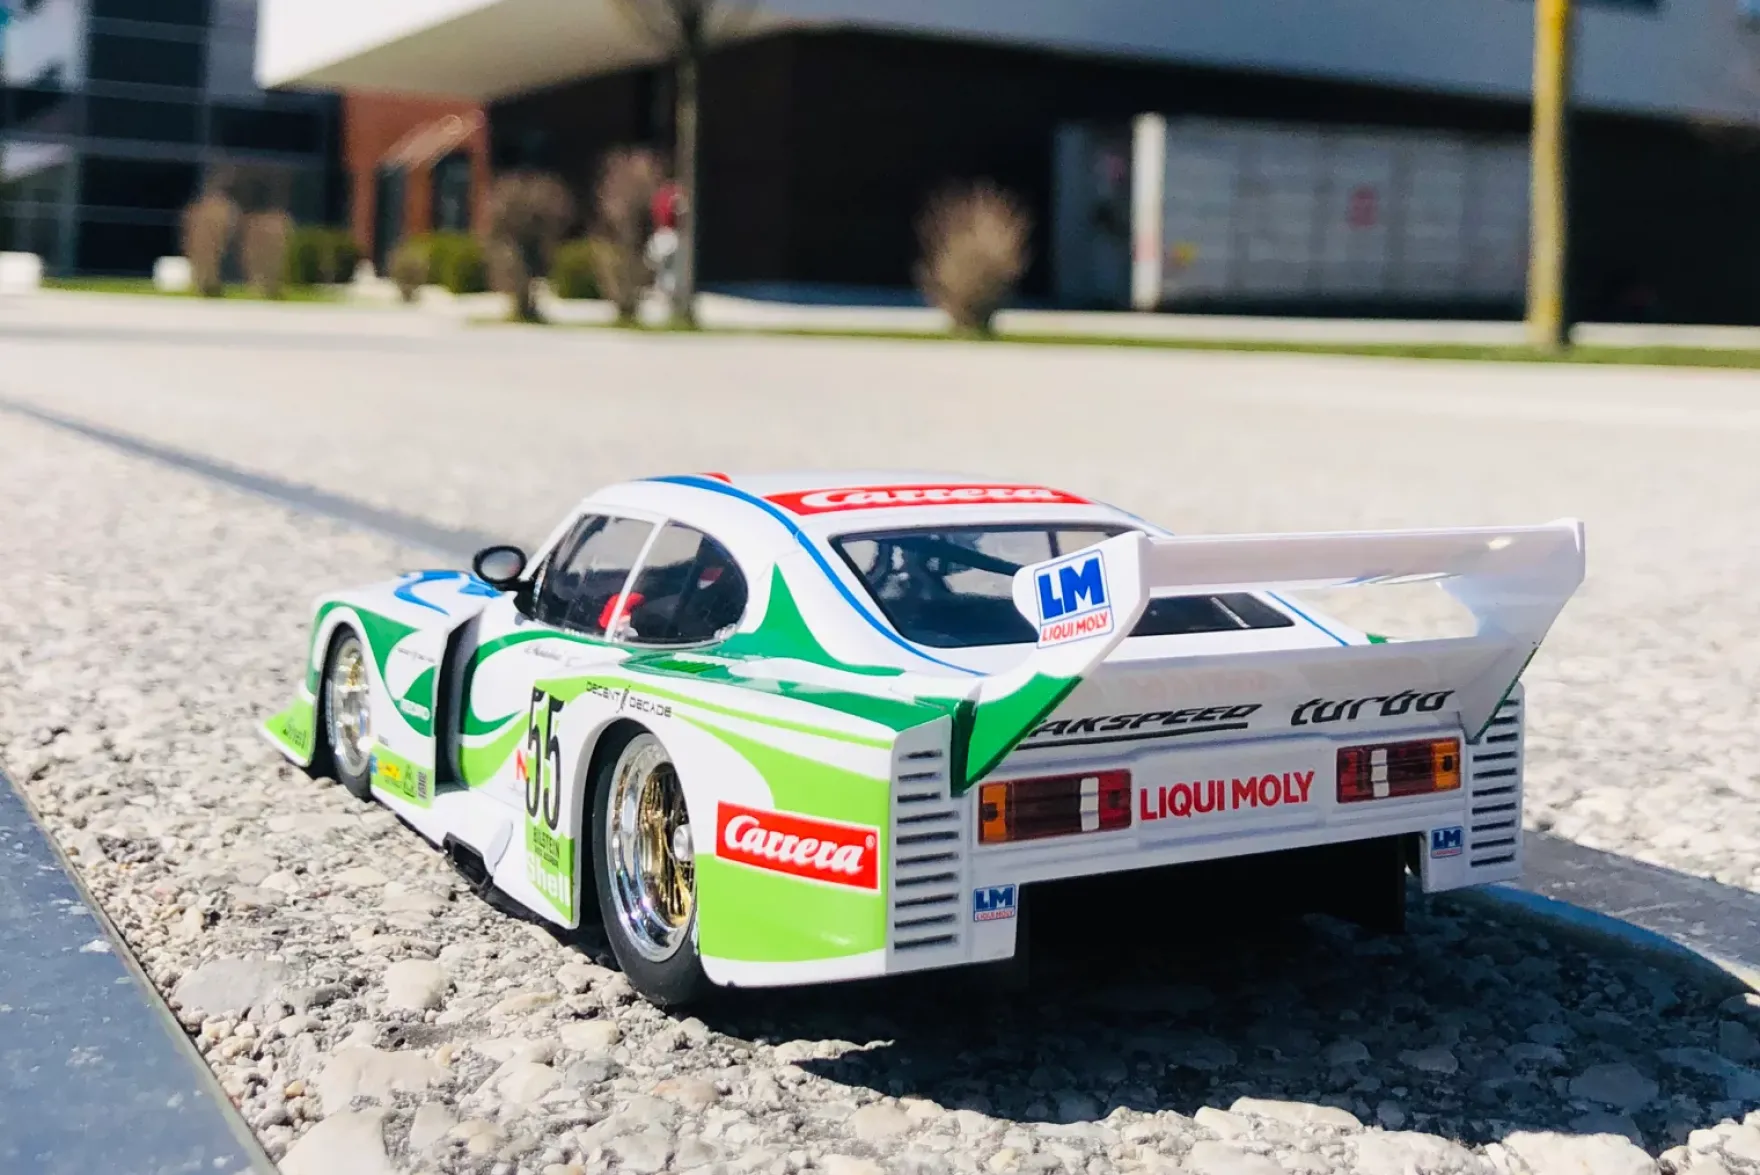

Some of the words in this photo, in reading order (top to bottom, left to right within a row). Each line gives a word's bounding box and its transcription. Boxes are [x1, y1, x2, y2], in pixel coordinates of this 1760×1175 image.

[802, 485, 1063, 507] Carrera
[1038, 557, 1105, 620] LM
[1041, 621, 1074, 642] LIQUI
[1075, 610, 1108, 635] MOLY
[586, 680, 621, 701] DECENT
[629, 695, 673, 718] DECADE
[1028, 703, 1263, 738] AKSPEED
[1290, 689, 1456, 727] turbo
[525, 686, 566, 831] 55
[1139, 782, 1226, 821] LIQUI
[1231, 770, 1316, 810] MOLY
[724, 814, 865, 876] Carrera
[1433, 829, 1462, 849] LM
[975, 887, 1014, 911] LM
